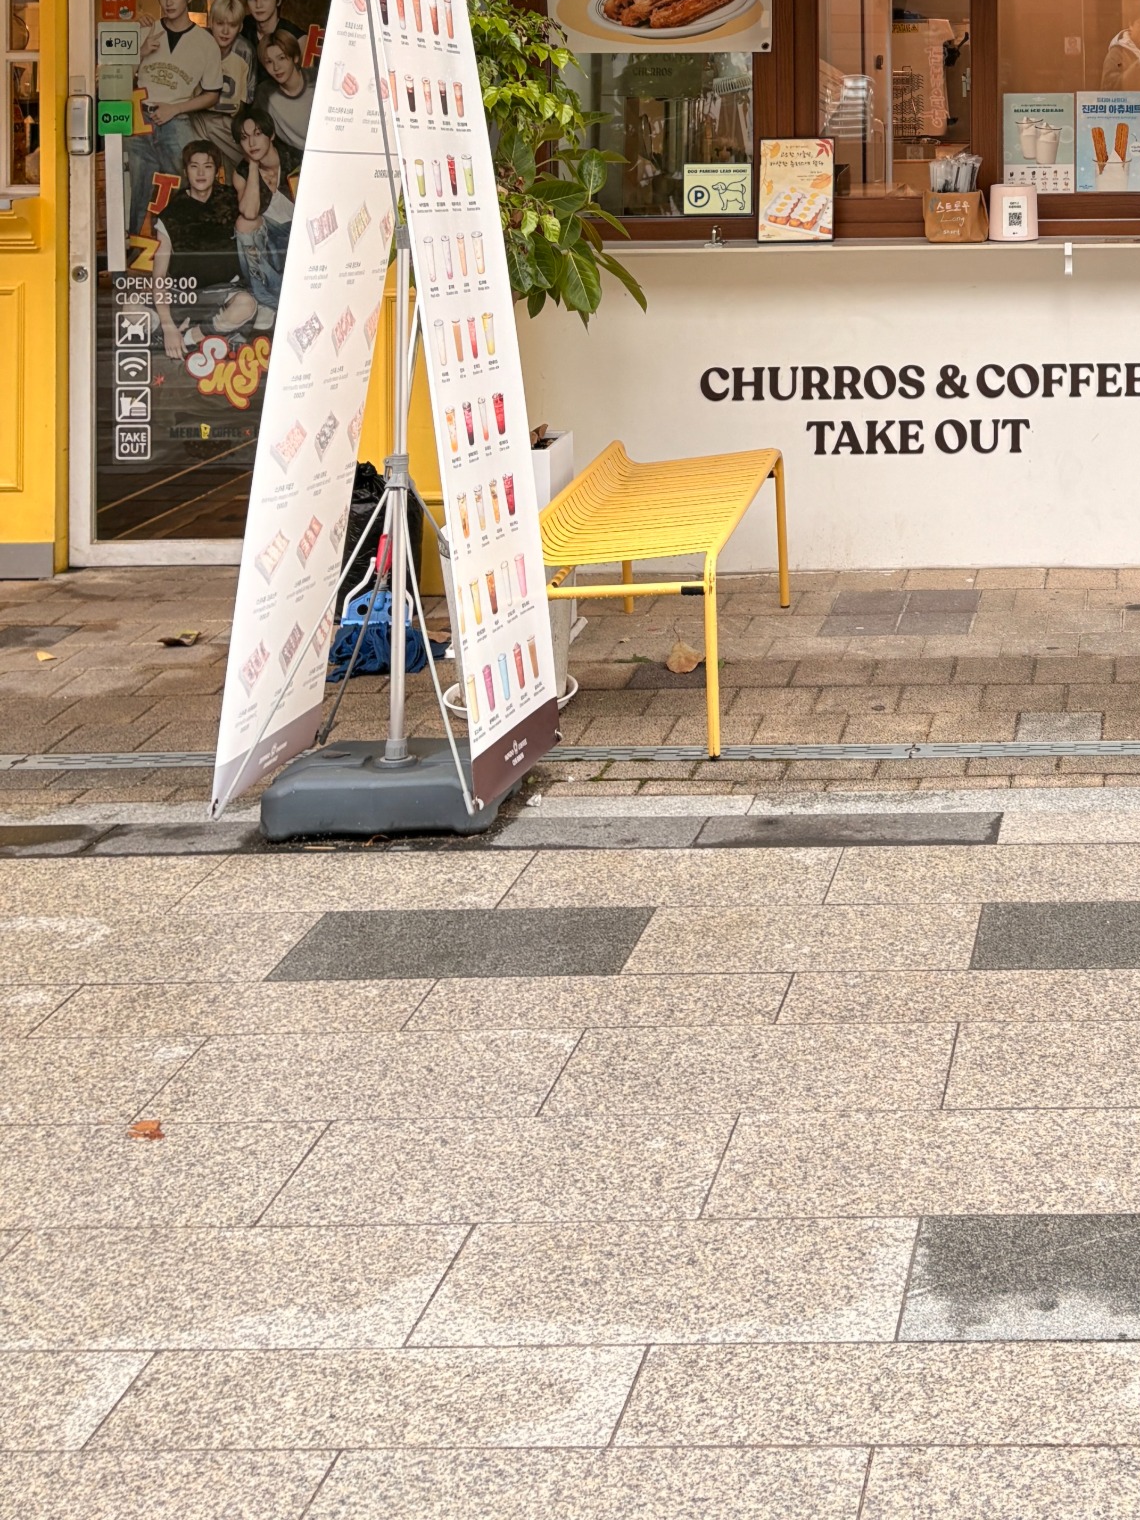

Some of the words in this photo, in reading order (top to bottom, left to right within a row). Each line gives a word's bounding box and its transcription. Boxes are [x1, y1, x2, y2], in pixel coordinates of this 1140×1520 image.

[114, 37, 134, 49] Pay
[1082, 104, 1107, 114] 진리의
[112, 114, 130, 123] pay
[694, 190, 705, 203] P
[936, 201, 970, 214] 스트로우
[115, 277, 153, 290] OPEN
[155, 276, 198, 289] 09:00
[115, 292, 153, 305] CLOSE
[155, 292, 198, 305] 23:00
[700, 364, 926, 402] CHURROS
[936, 364, 969, 400] &
[119, 432, 147, 443] TAKE
[806, 420, 925, 456] TAKE
[935, 418, 1031, 455] OUT
[120, 443, 147, 454] OUT
